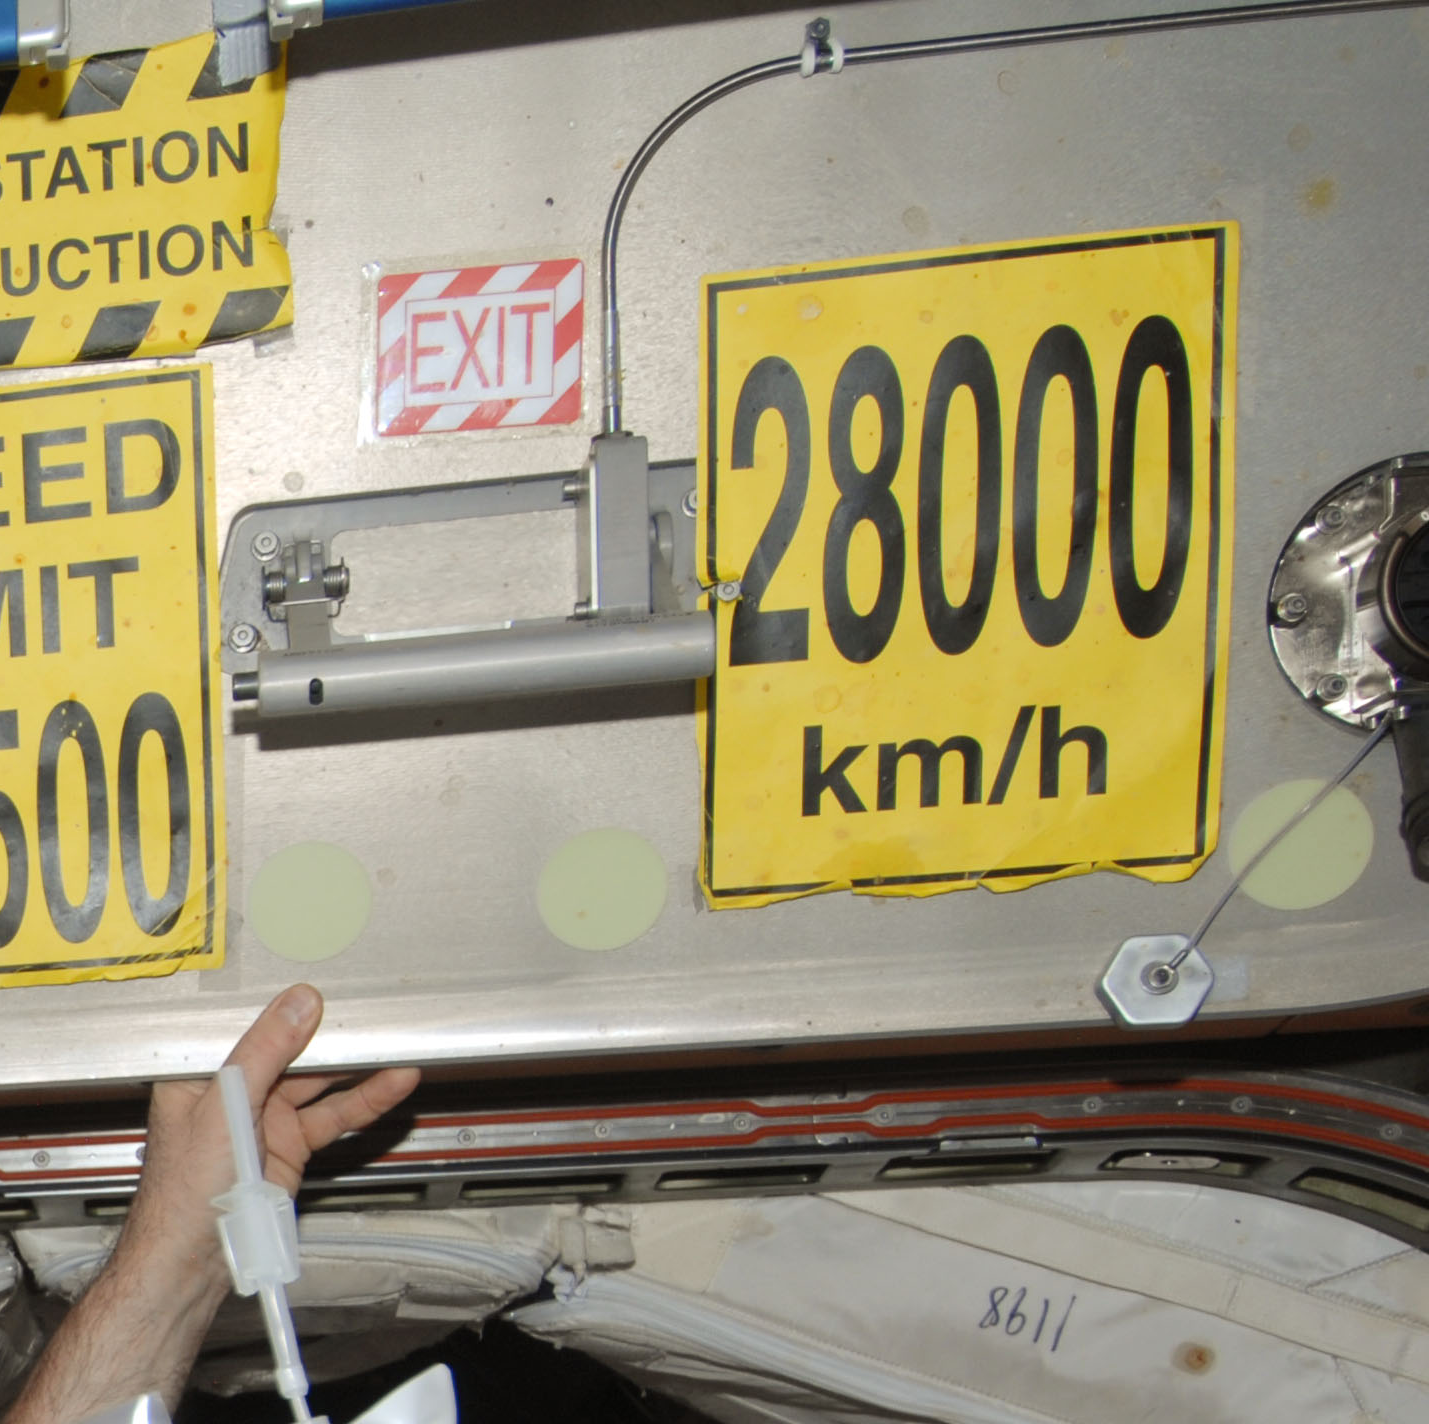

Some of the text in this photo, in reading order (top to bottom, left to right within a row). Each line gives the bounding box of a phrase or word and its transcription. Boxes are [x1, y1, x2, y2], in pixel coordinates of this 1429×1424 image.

[410, 301, 550, 394] EXIT
[728, 314, 1195, 668] 28000
[801, 705, 1109, 818] km/h
